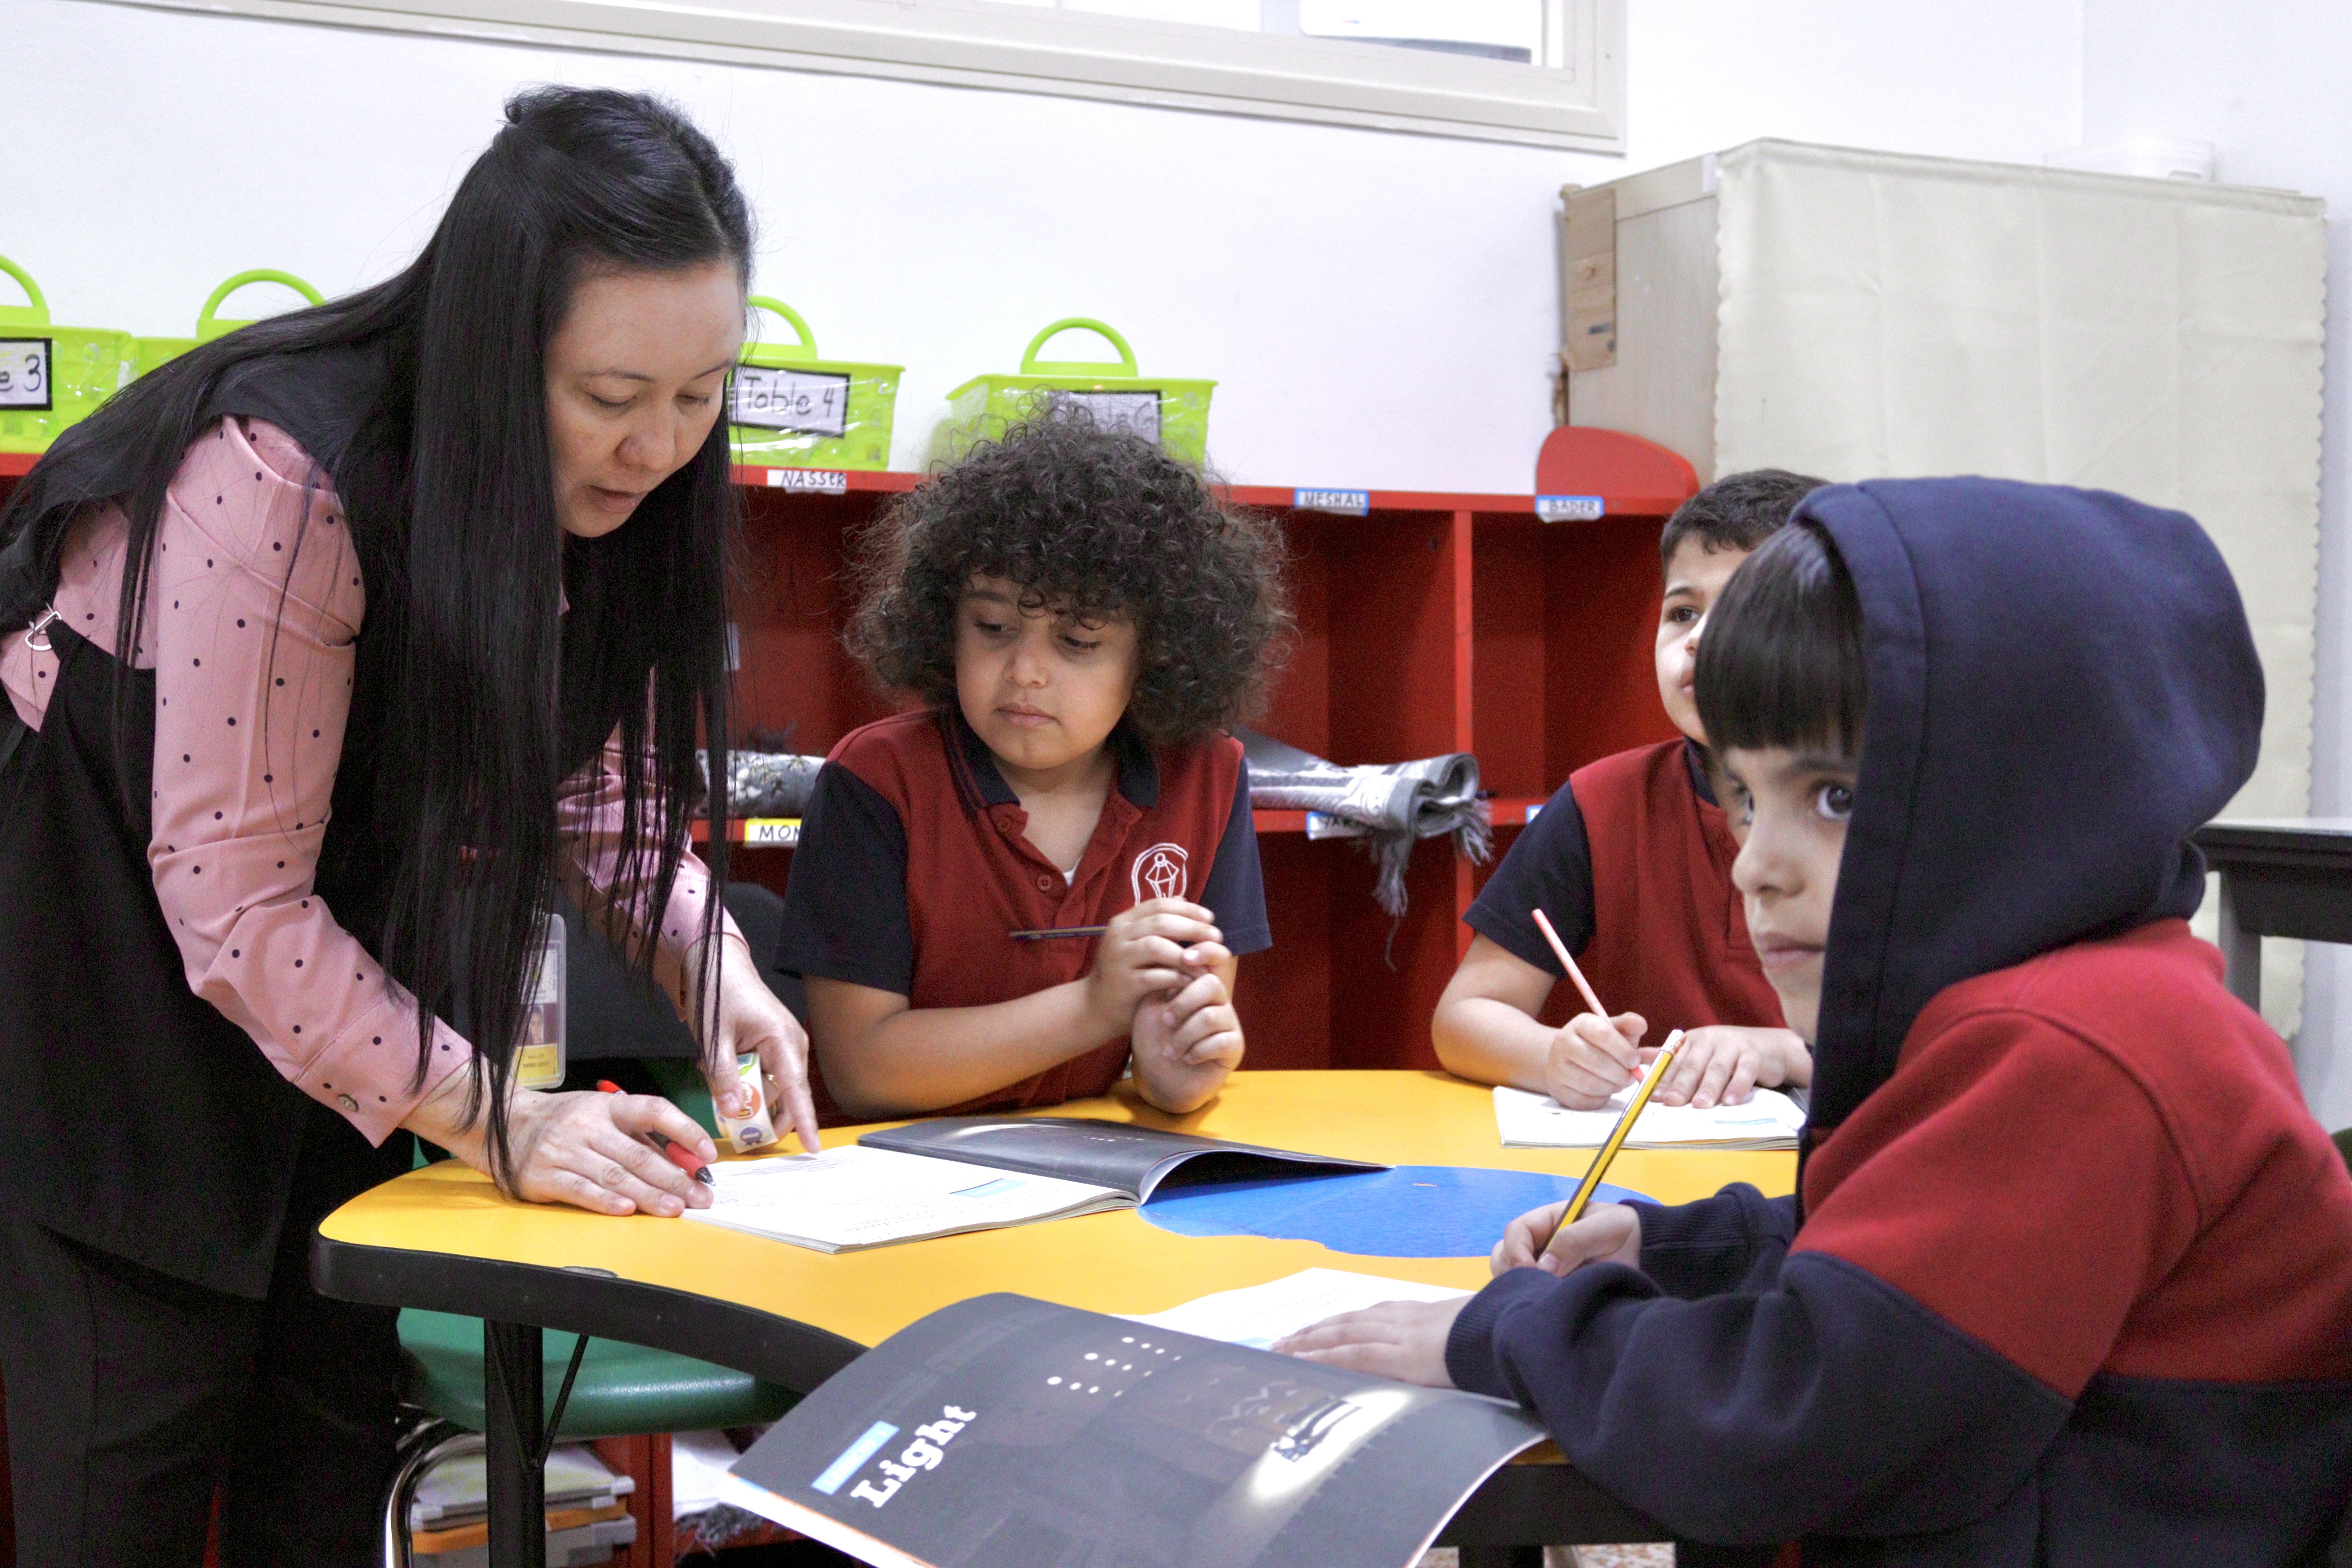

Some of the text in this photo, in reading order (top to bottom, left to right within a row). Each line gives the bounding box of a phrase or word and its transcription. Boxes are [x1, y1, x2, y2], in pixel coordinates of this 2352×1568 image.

[24, 354, 42, 392] 3
[744, 376, 834, 417] Table 4
[781, 471, 845, 487] NASSER
[1305, 492, 1363, 506] MESHAL
[1550, 500, 1595, 513] BADER
[850, 1405, 977, 1508] Light
